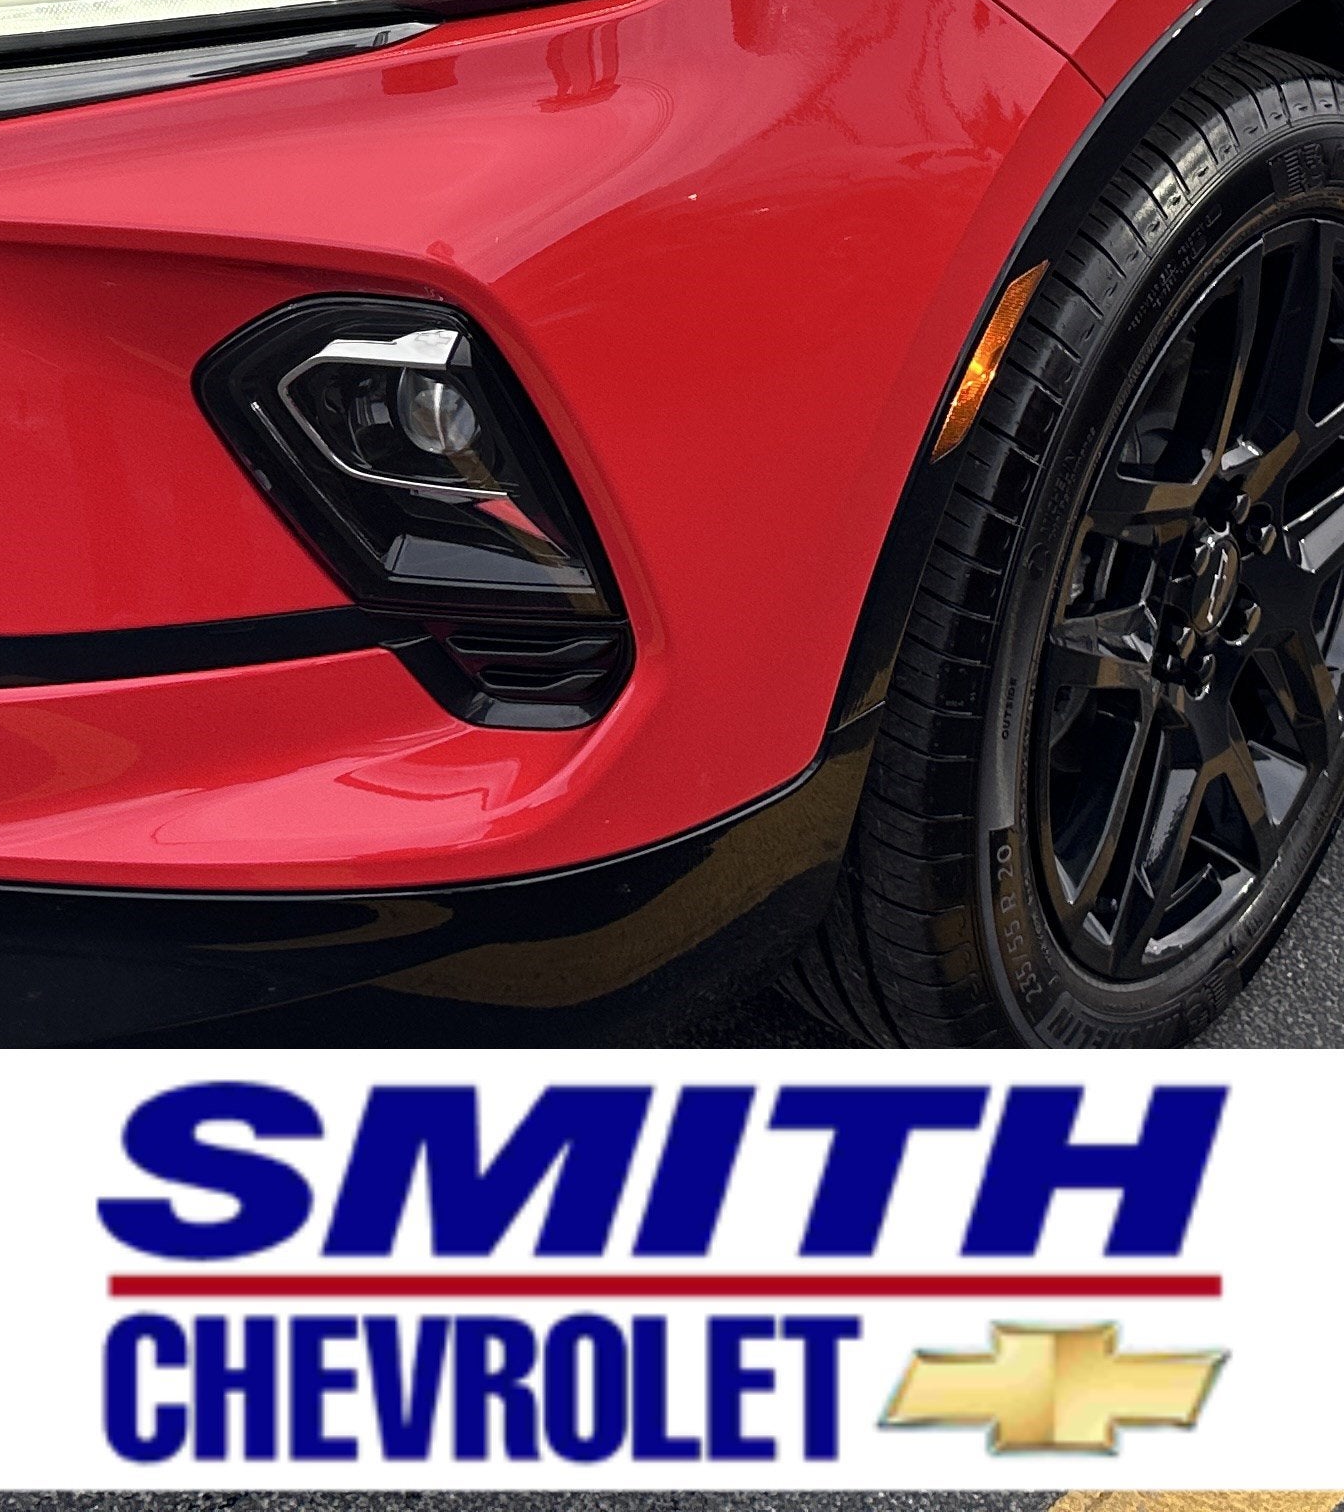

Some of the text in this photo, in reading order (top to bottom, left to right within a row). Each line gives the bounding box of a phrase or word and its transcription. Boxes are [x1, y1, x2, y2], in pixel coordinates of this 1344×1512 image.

[1001, 676, 1017, 740] OUTSIDE
[996, 844, 1014, 881] 20
[1000, 892, 1017, 914] R
[1007, 919, 1043, 1004] 235/55
